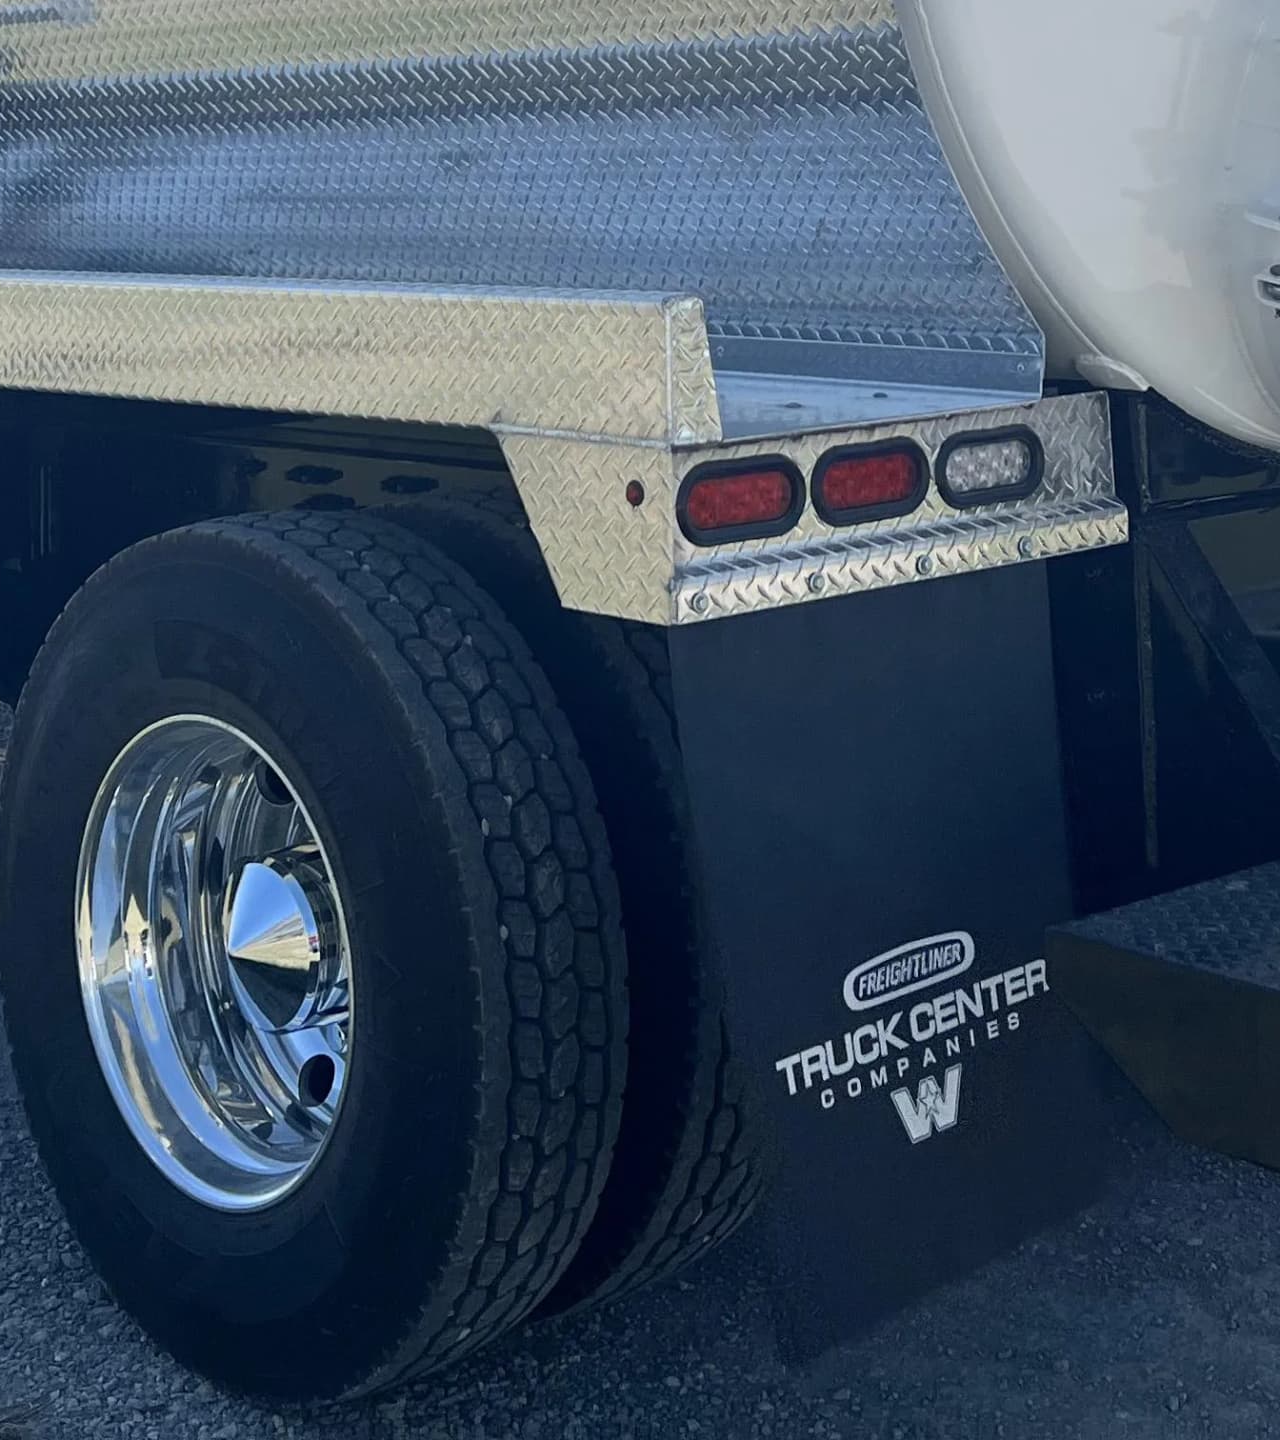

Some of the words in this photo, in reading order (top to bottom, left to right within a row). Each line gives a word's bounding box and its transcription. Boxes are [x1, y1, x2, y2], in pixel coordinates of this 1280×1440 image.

[857, 941, 962, 999] FREIGHTLINER
[775, 1010, 910, 1096] TRUCK
[909, 958, 1051, 1043] CENTER
[820, 1011, 1021, 1110] COMPANIES
